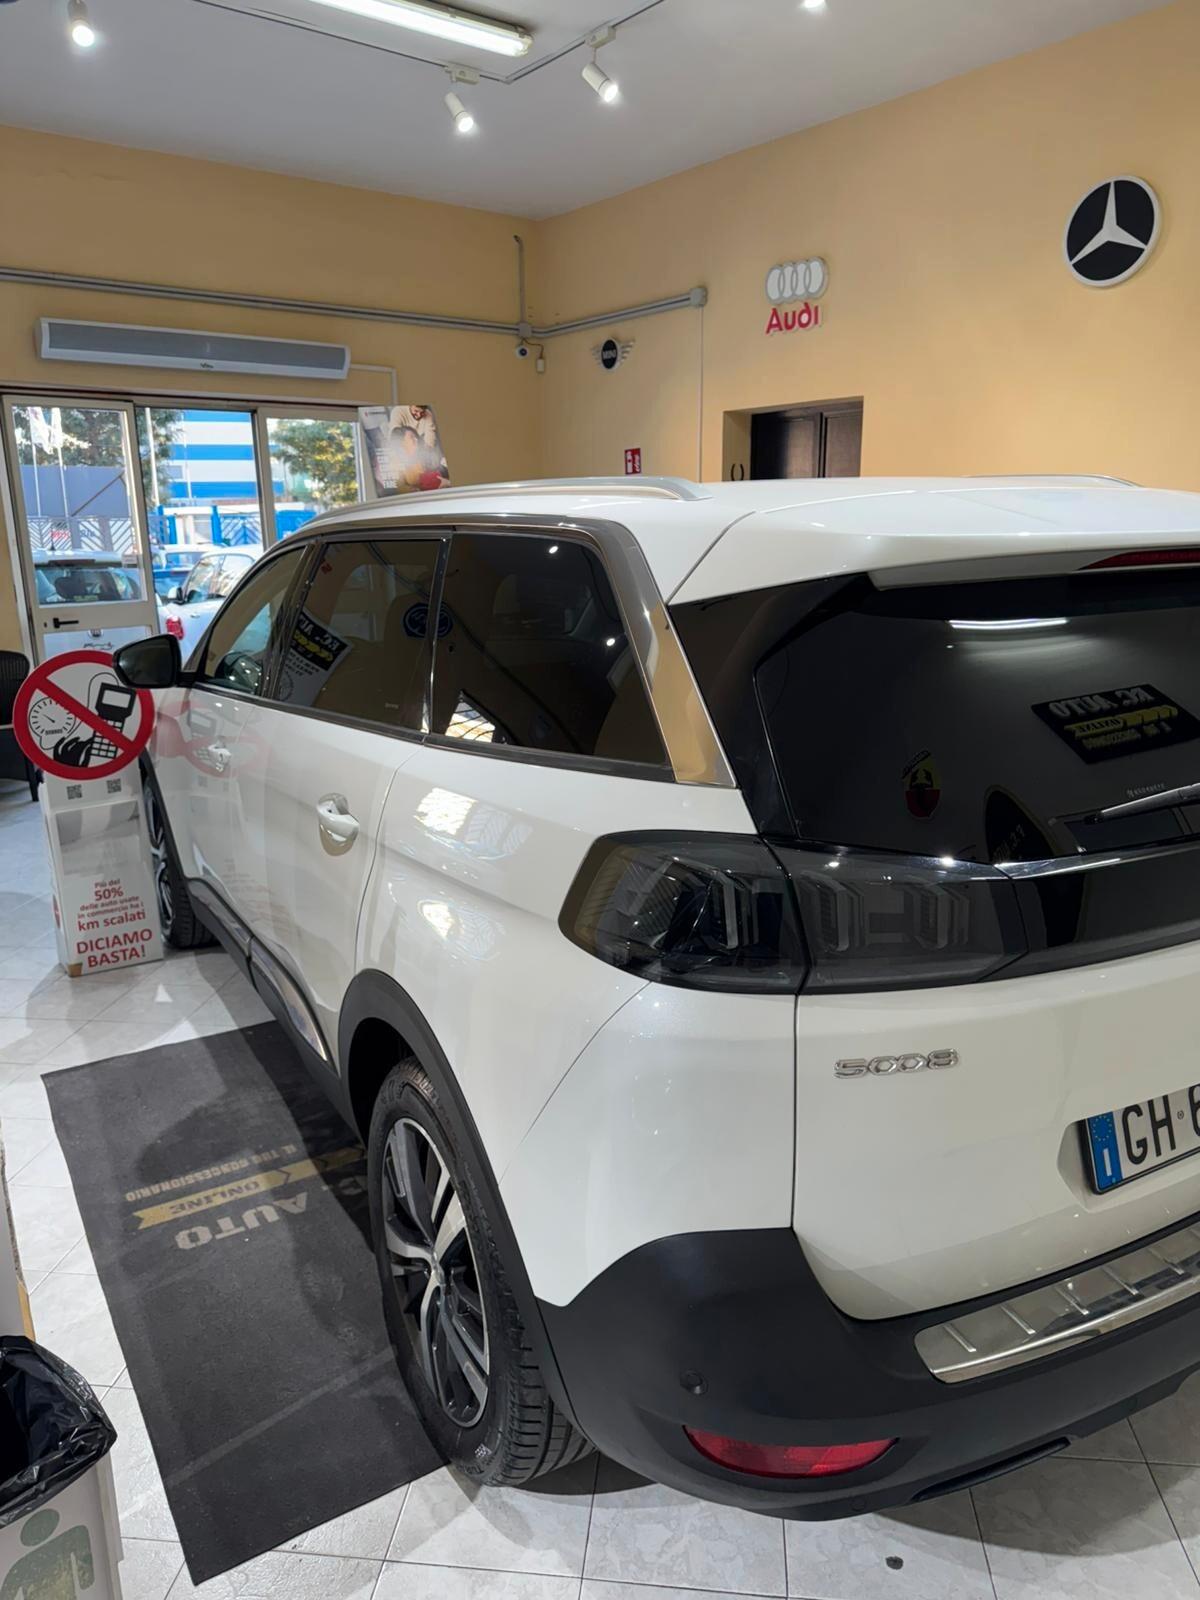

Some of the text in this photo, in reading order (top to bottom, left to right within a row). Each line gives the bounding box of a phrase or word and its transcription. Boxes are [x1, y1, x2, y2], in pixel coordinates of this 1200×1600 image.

[765, 301, 819, 335] Audi
[80, 896, 139, 911] delle auto usate
[94, 886, 124, 902] 50%
[77, 907, 146, 932] km scalati
[86, 906, 129, 918] commercio
[76, 928, 153, 955] DICIAMO
[87, 944, 146, 968] BASTA!
[832, 1048, 960, 1079] 5008
[125, 1158, 251, 1202] CONCESSIONARIO
[168, 1180, 262, 1215] ONLINE
[174, 1191, 309, 1250] AUTO
